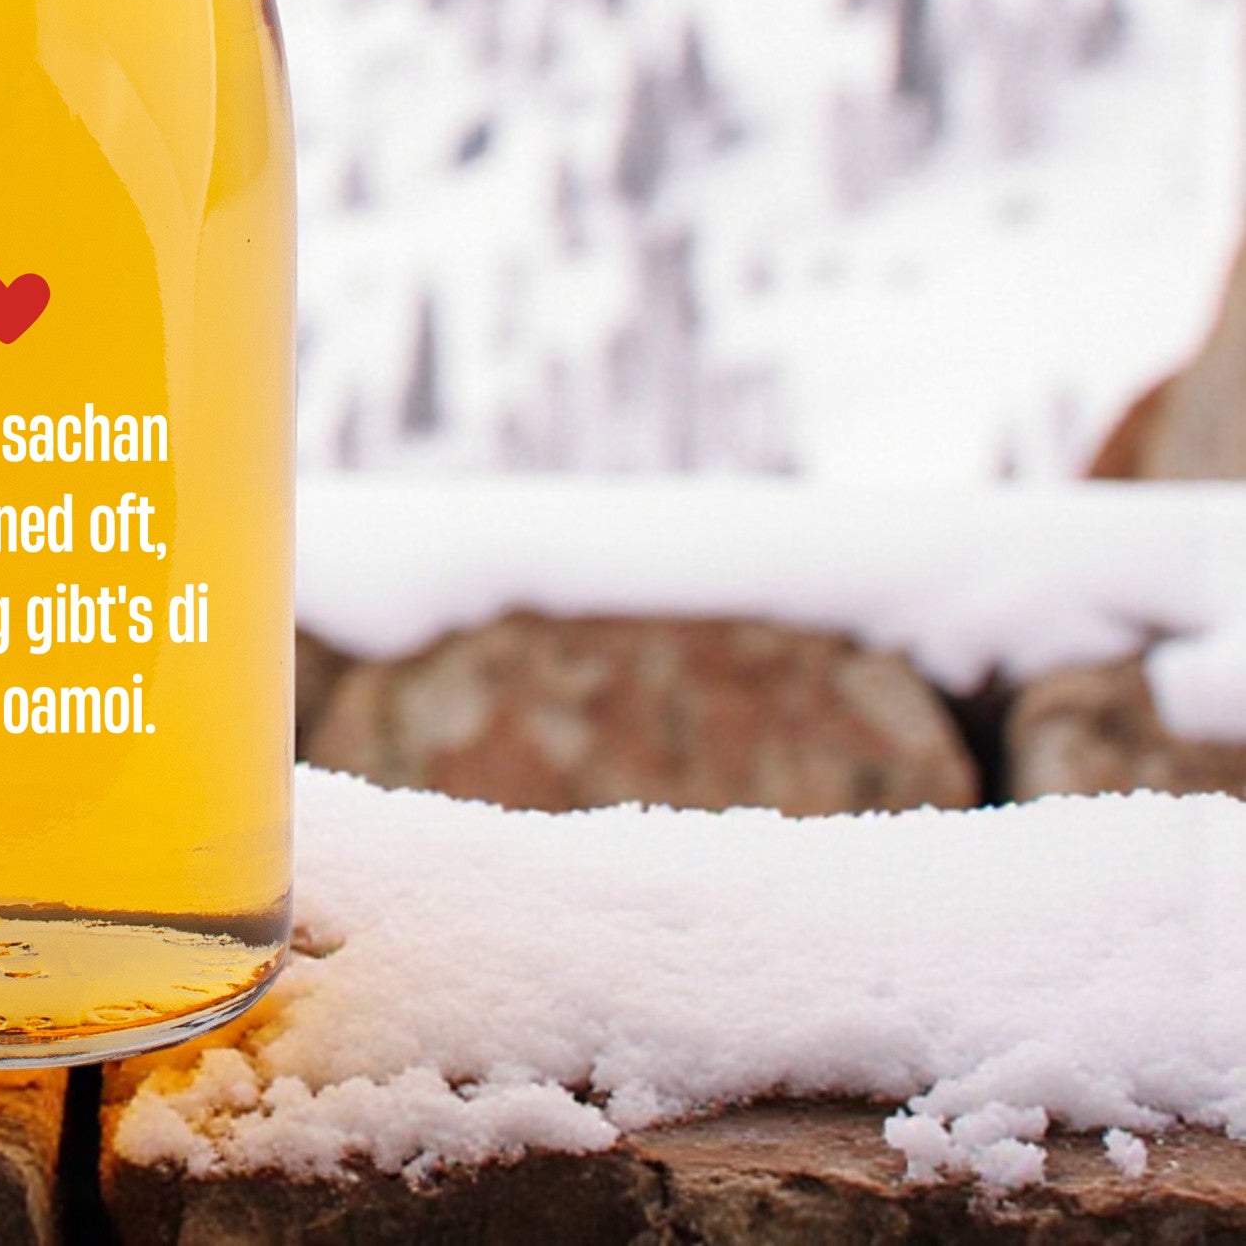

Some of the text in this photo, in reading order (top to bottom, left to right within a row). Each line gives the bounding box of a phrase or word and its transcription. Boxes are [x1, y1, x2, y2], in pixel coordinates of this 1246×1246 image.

[1, 403, 167, 462] sachan
[89, 492, 167, 560] oft,
[26, 583, 153, 655] gibt's
[168, 583, 208, 643] di
[2, 673, 155, 734] oamoi.
